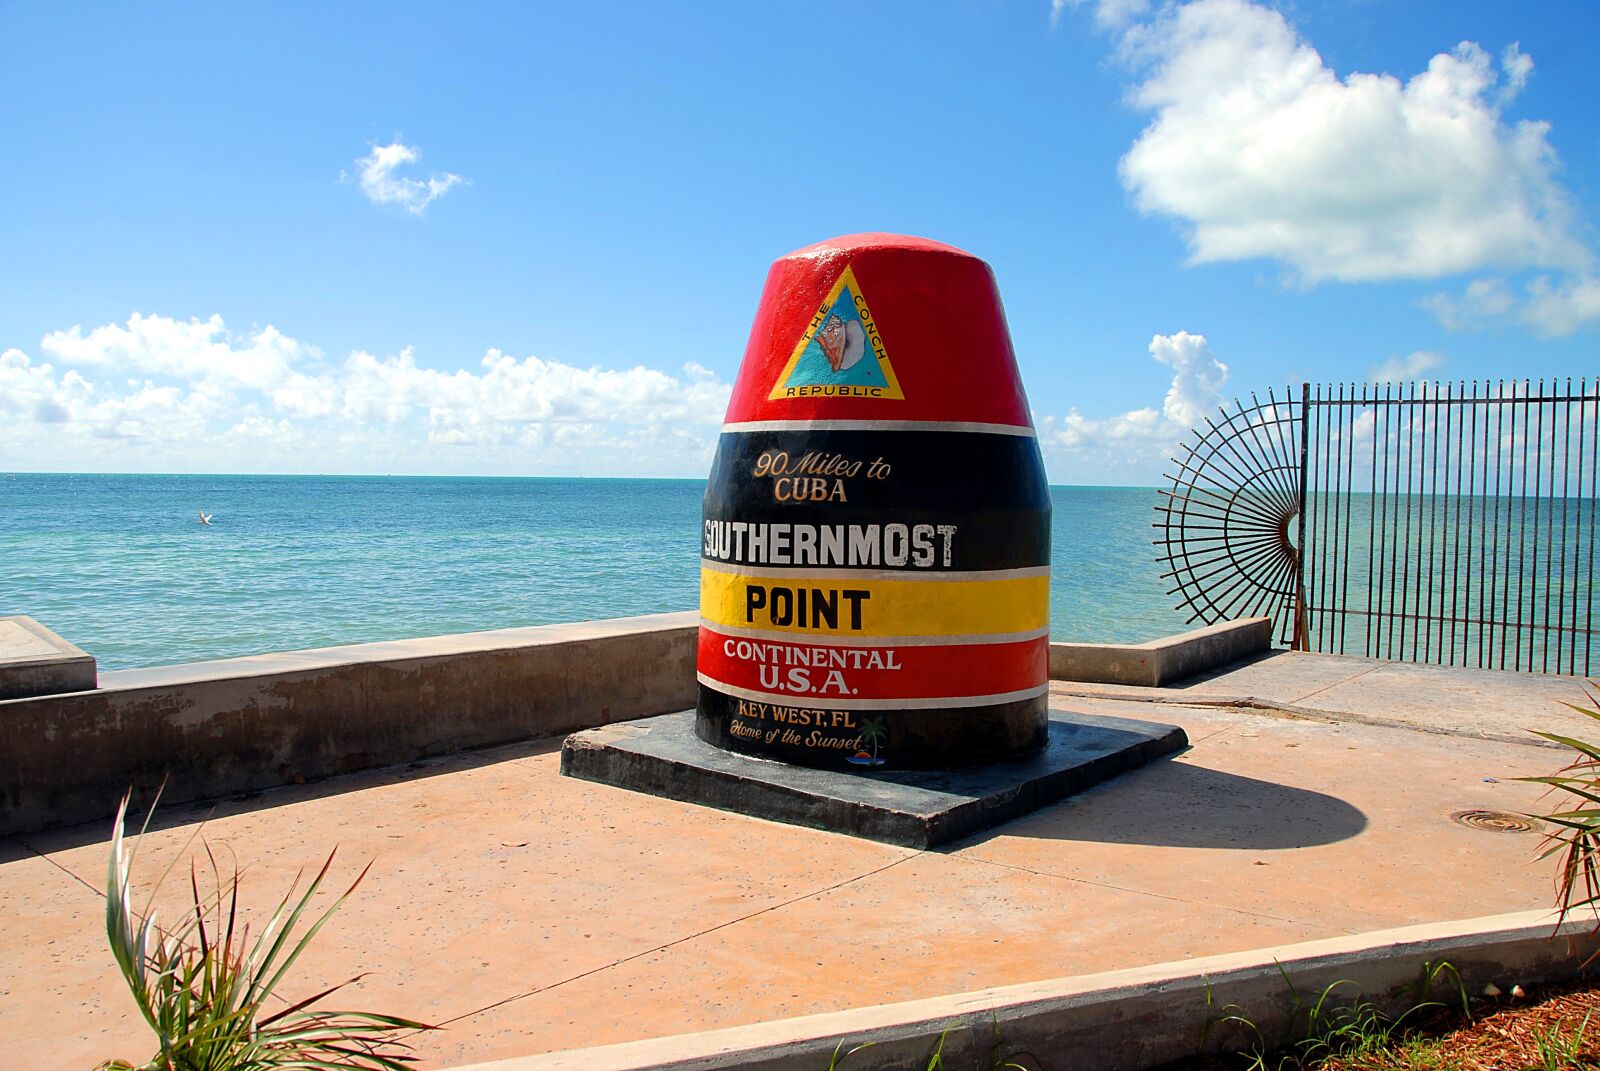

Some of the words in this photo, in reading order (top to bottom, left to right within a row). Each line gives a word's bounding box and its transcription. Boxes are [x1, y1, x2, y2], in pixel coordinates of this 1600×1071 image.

[802, 303, 830, 341] THE
[854, 295, 887, 360] CONCH
[786, 386, 882, 397] REPUBLIC
[753, 451, 789, 478] 90
[785, 451, 863, 477] Miles
[866, 456, 892, 480] to
[774, 477, 848, 502] CUBA
[704, 519, 958, 567] SOUTHERNMOST
[746, 585, 871, 630] POINT
[723, 639, 902, 670] CONTINENTAL
[759, 664, 859, 695] U.S.A.
[738, 700, 768, 719] KEY
[771, 706, 828, 728] WEST,
[831, 711, 857, 728] FL
[730, 719, 762, 740] Home
[765, 728, 780, 744] of
[781, 728, 801, 746] the
[804, 730, 864, 750] Sunset
